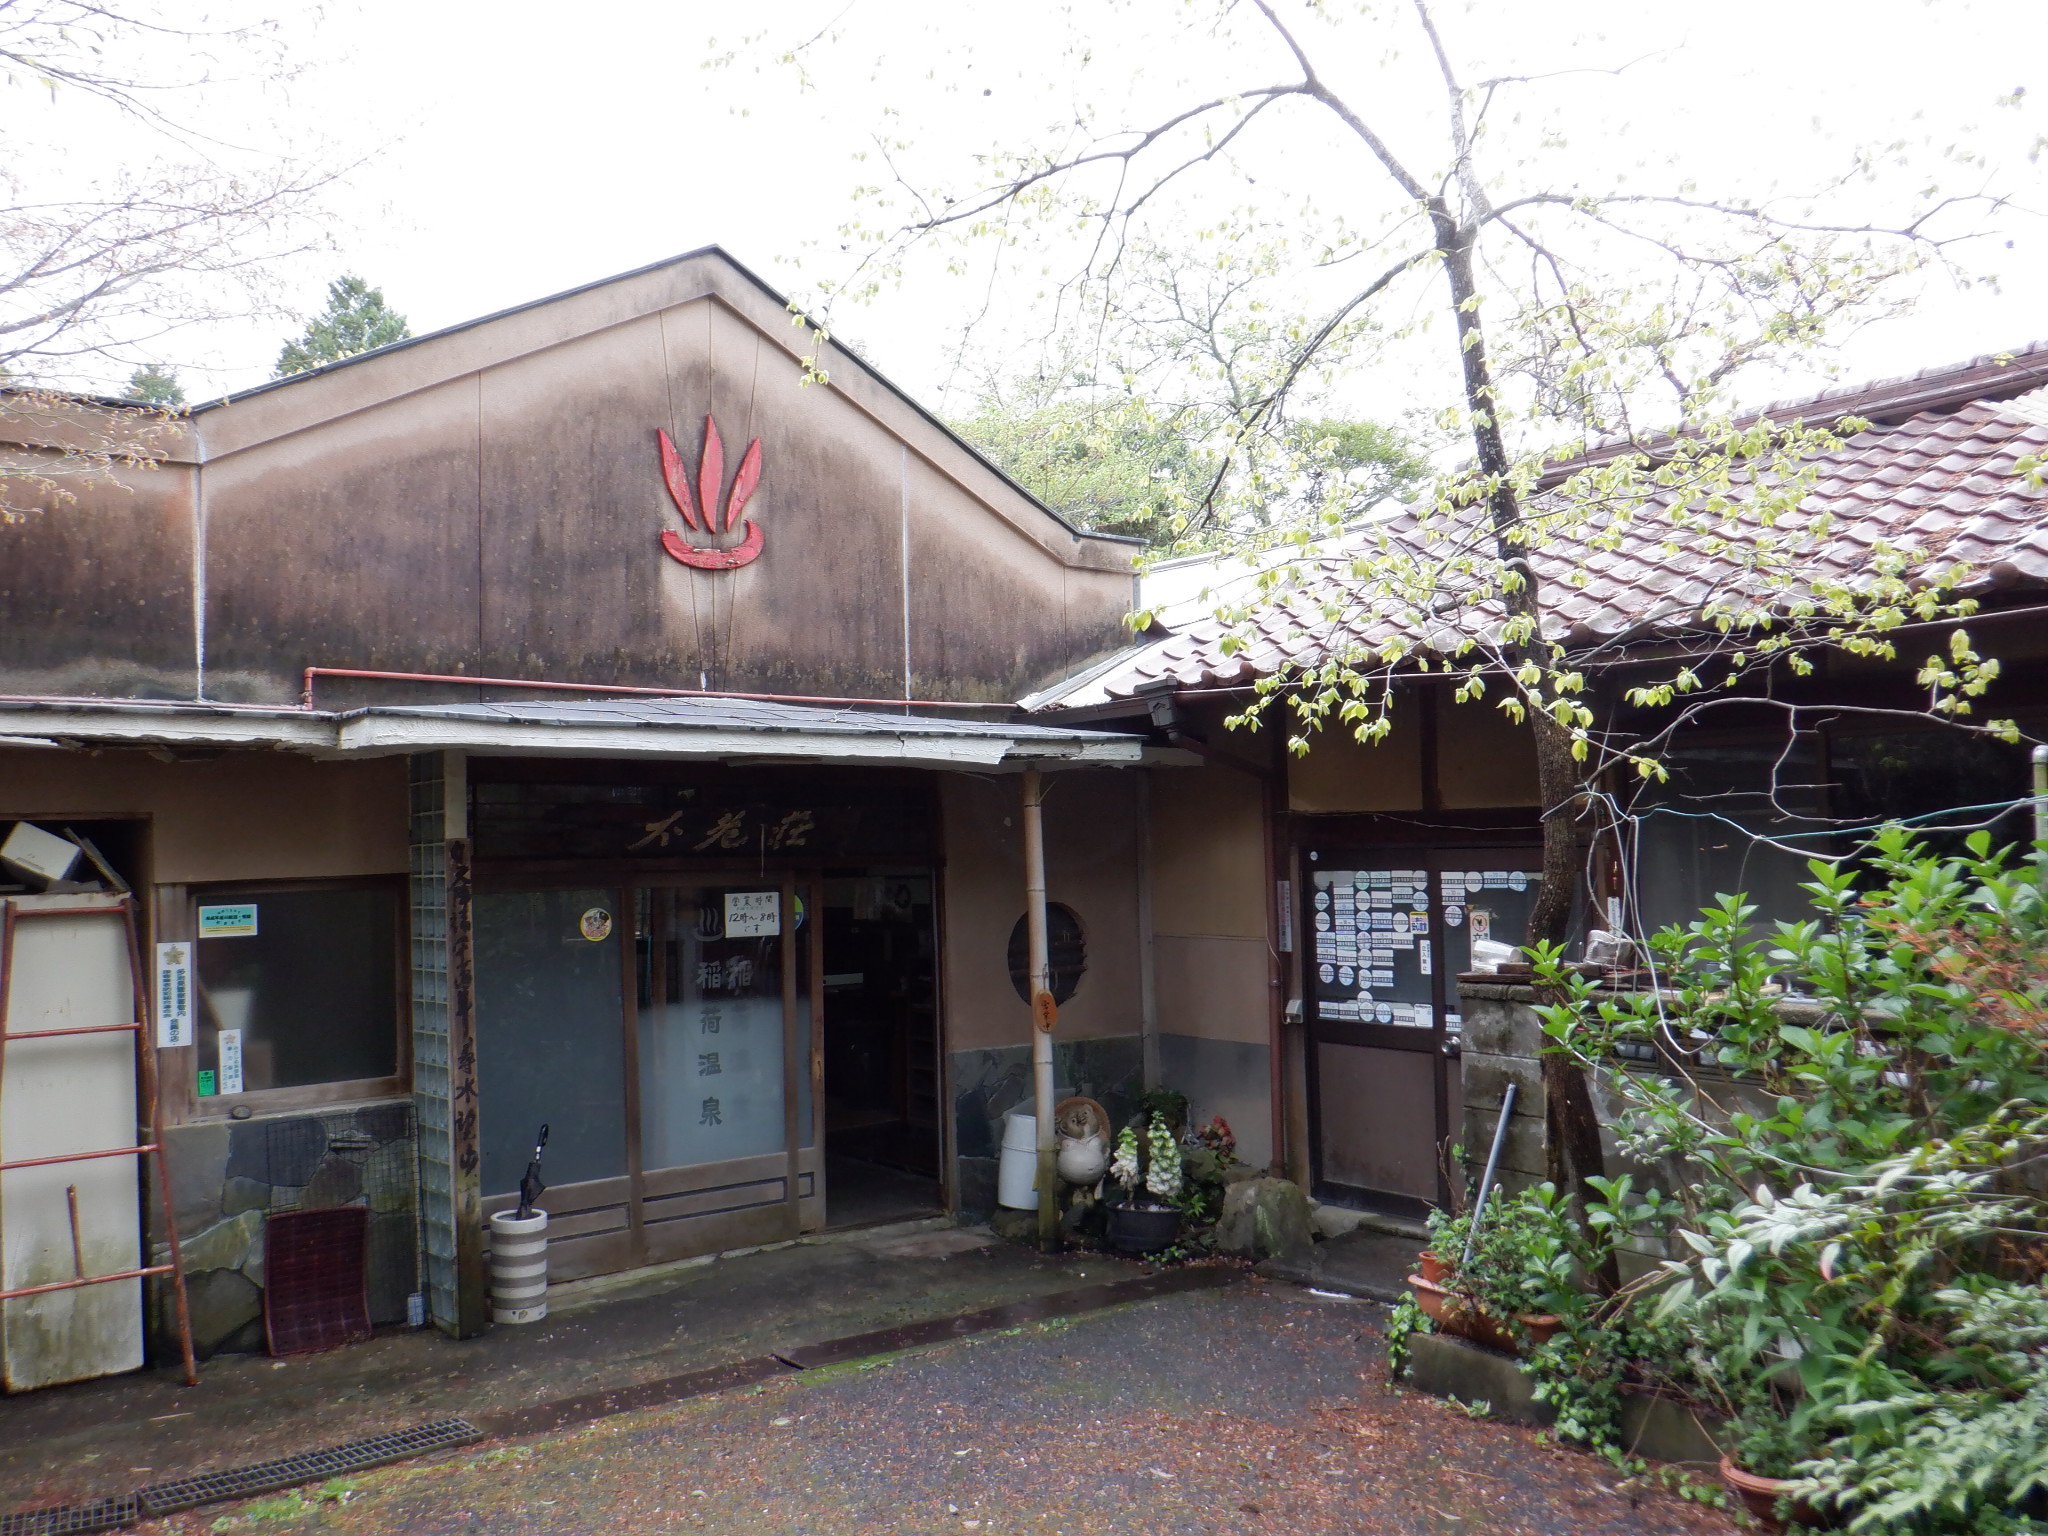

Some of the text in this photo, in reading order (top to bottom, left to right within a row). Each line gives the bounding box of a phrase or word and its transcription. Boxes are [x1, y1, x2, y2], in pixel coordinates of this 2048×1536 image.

[732, 895, 773, 907] 営業時間
[696, 960, 723, 1127] 稲荷温泉
